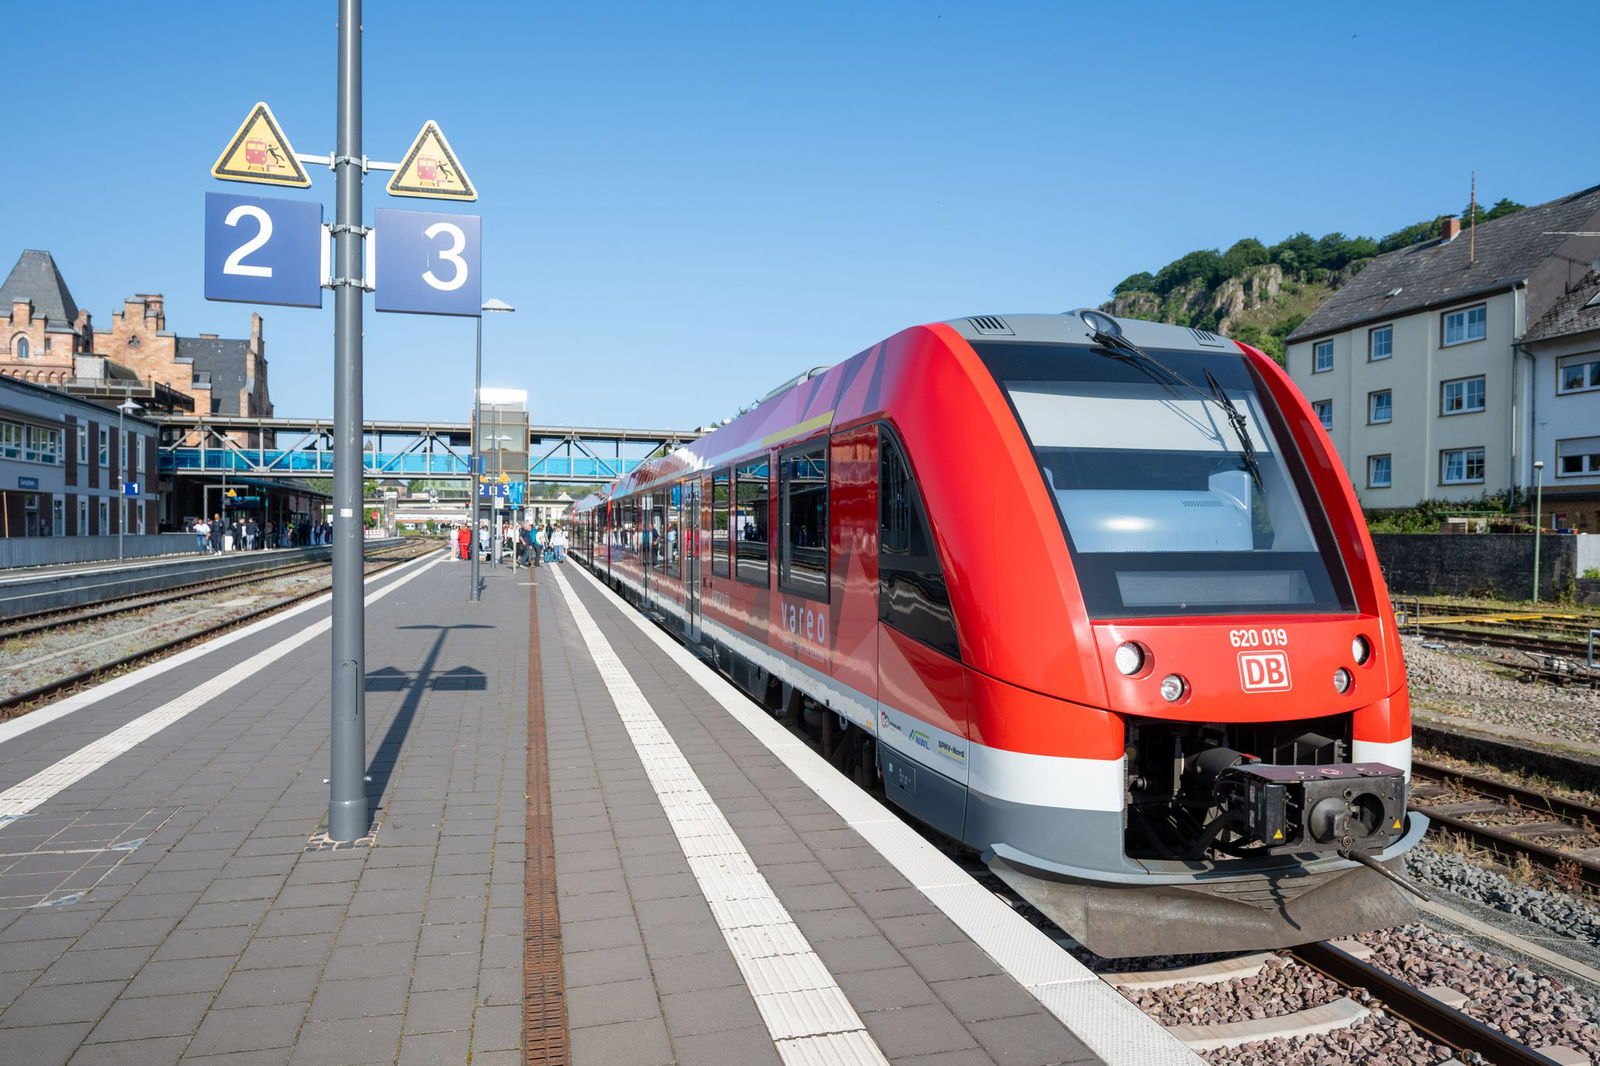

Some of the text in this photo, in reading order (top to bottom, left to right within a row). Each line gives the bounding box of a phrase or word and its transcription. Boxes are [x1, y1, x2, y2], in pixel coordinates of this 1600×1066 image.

[223, 205, 273, 277] 2
[422, 222, 468, 291] 3
[132, 483, 138, 493] 1
[479, 484, 485, 495] 2
[502, 484, 510, 496] 3
[780, 602, 825, 643] vareo
[1230, 628, 1288, 647] 620 019
[1245, 657, 1285, 685] DB
